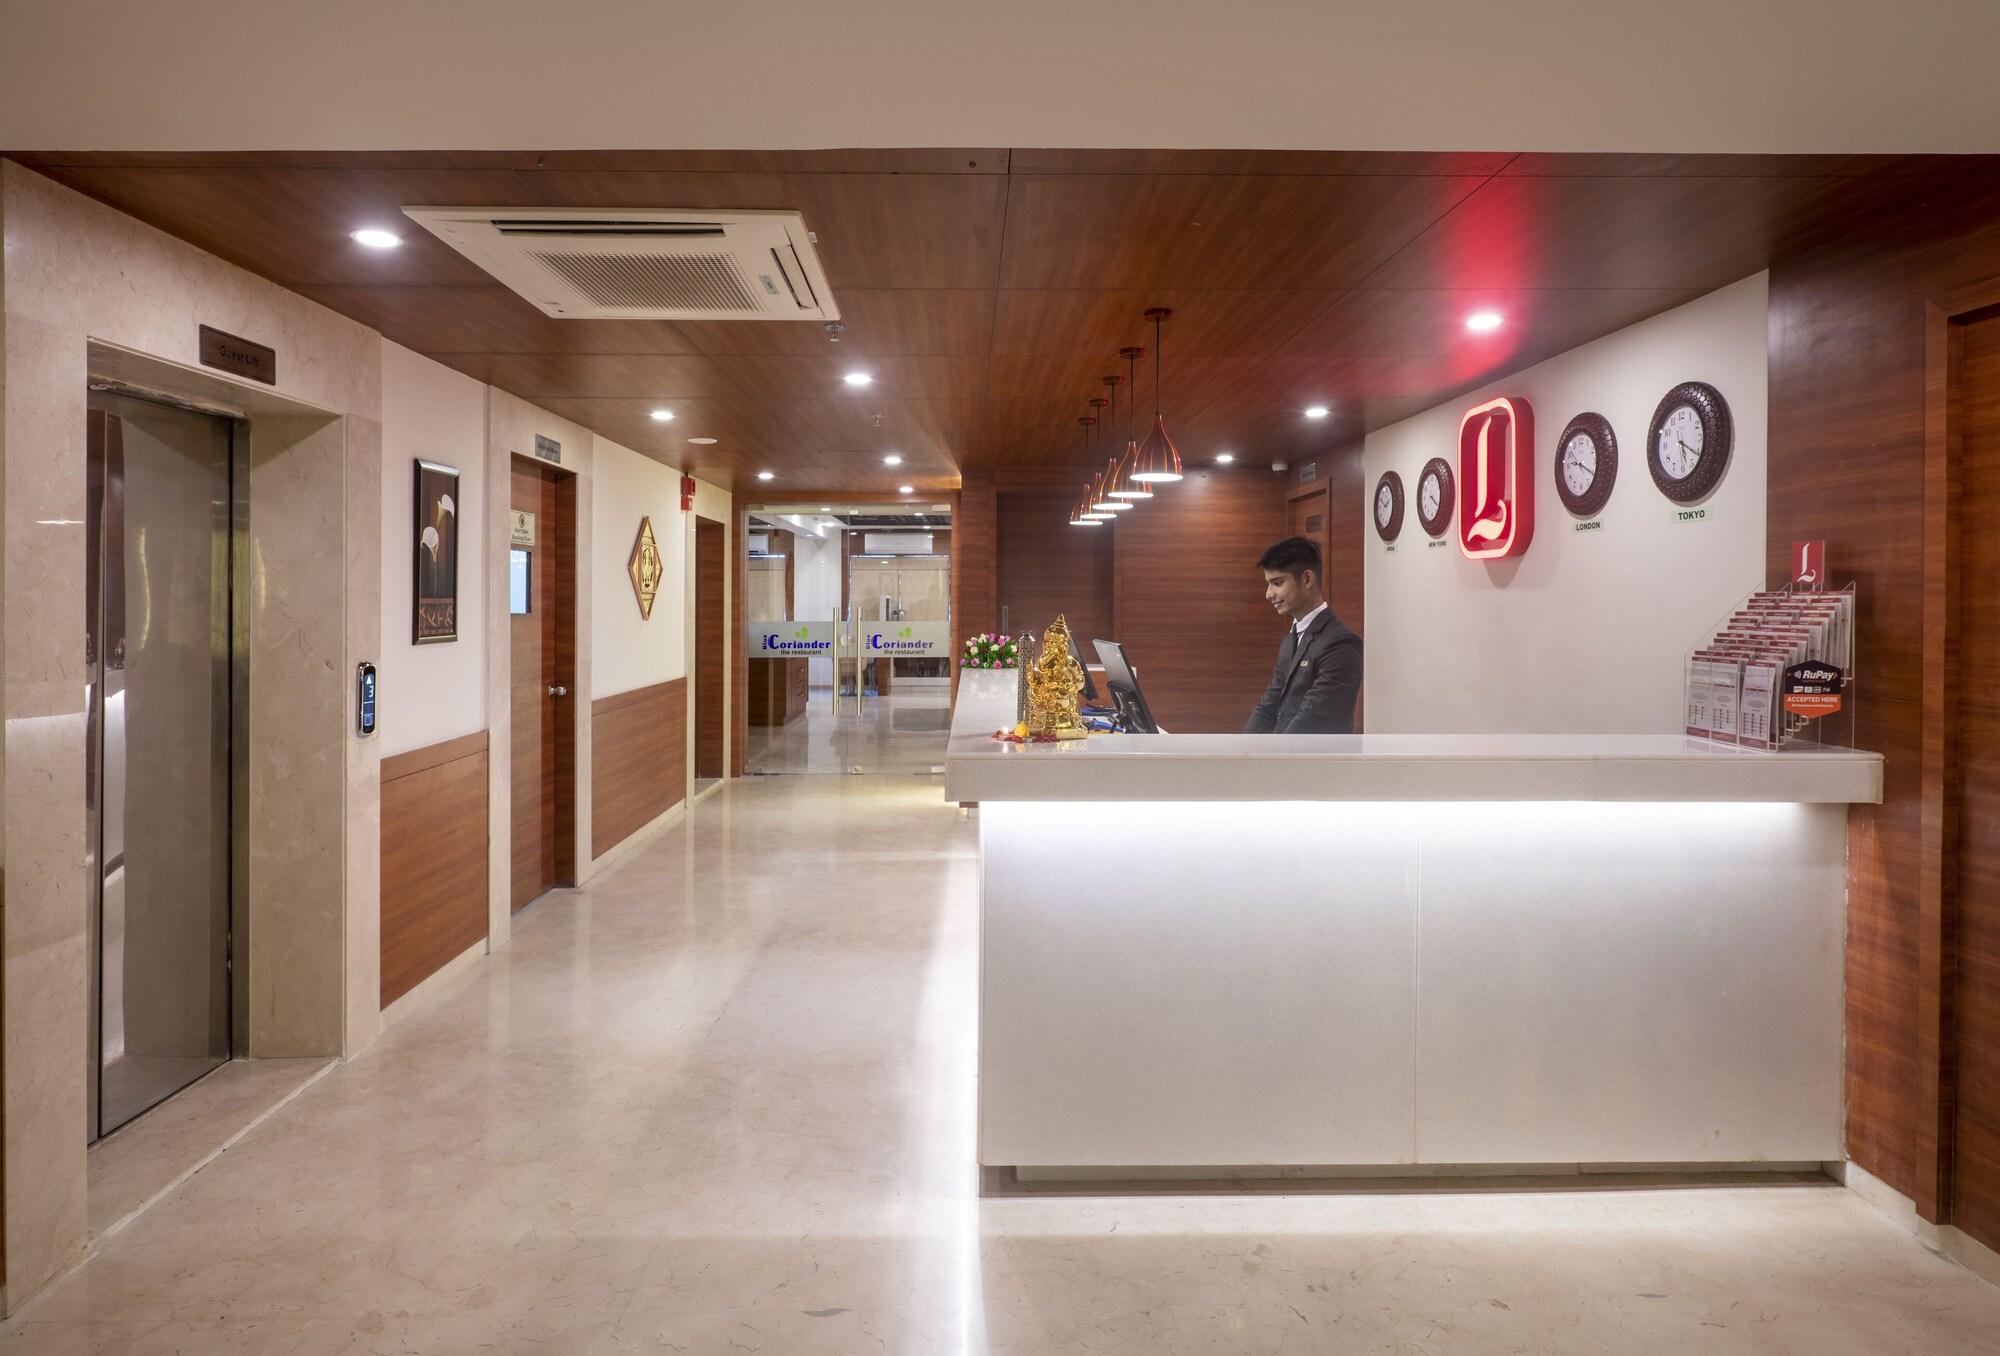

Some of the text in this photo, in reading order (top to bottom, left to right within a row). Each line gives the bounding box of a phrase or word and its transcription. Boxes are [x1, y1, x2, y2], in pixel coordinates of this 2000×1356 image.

[1678, 510, 1705, 520] TOKYO
[1576, 521, 1601, 531] LONDON
[1797, 542, 1816, 582] L
[768, 634, 831, 650] Coriander
[871, 634, 935, 650] Coriander
[1803, 670, 1834, 681] RuPay
[368, 685, 374, 698] 3
